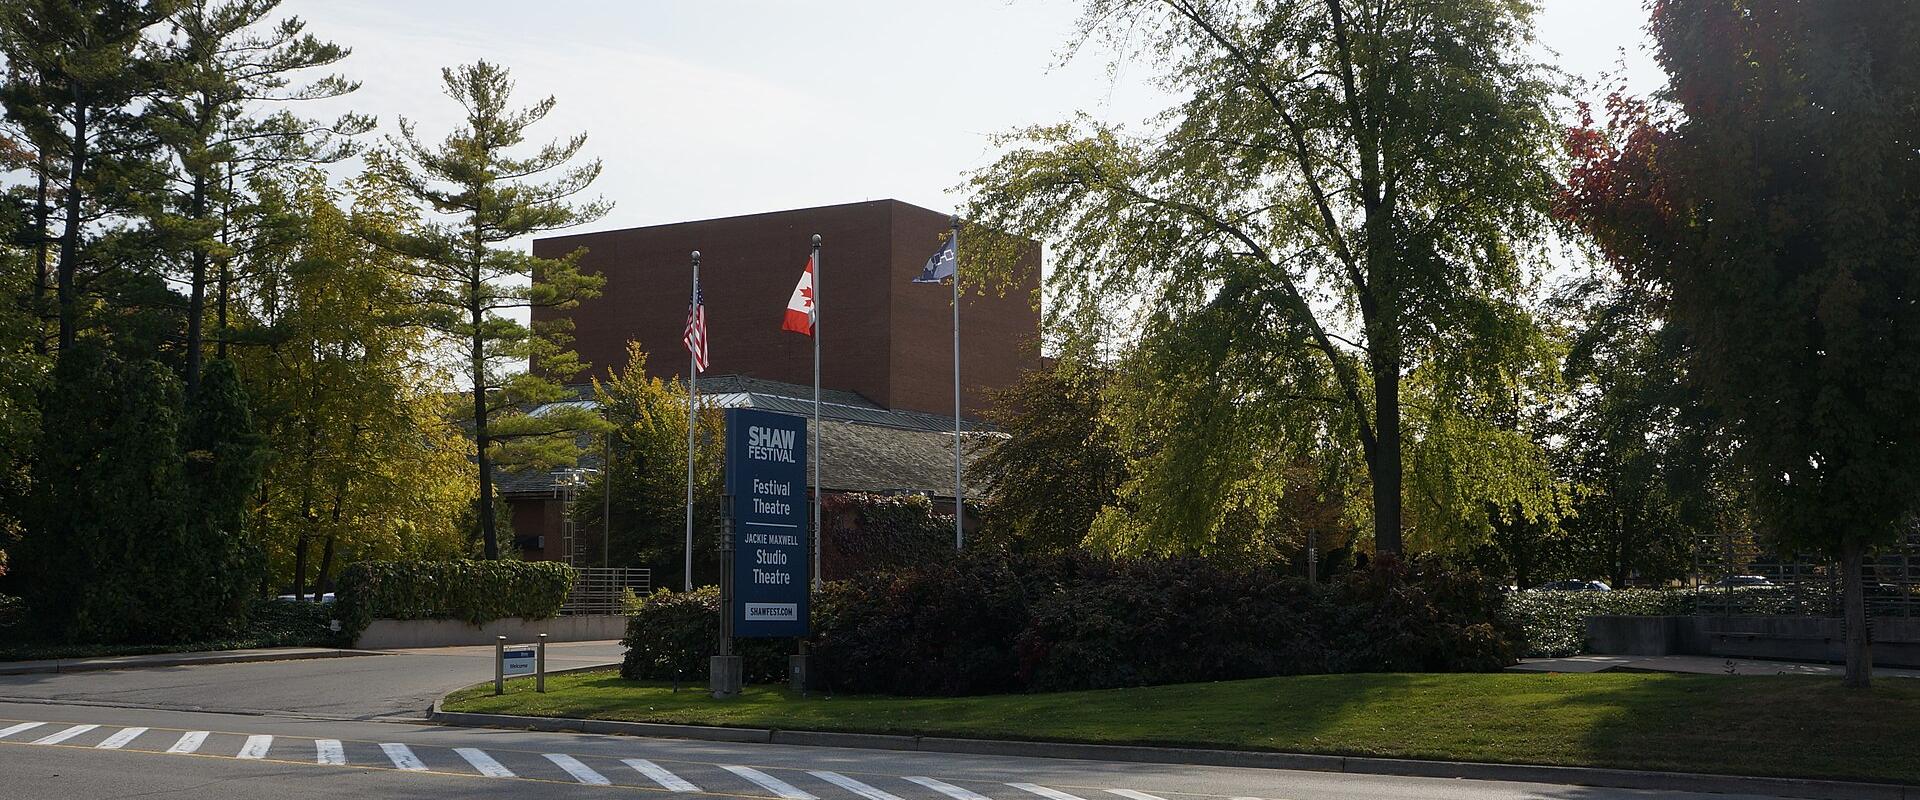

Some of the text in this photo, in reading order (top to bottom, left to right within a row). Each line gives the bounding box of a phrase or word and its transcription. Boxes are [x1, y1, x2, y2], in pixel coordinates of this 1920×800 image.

[748, 425, 796, 450] SHAW
[748, 446, 796, 463] FESTIVAL
[753, 478, 790, 496] Festival
[753, 498, 790, 515] Theatre
[745, 533, 798, 546] JACKIE MAXWELL
[756, 549, 787, 565] Studio
[753, 568, 790, 585] Theatre
[750, 607, 793, 616] SHAWFEST.COM
